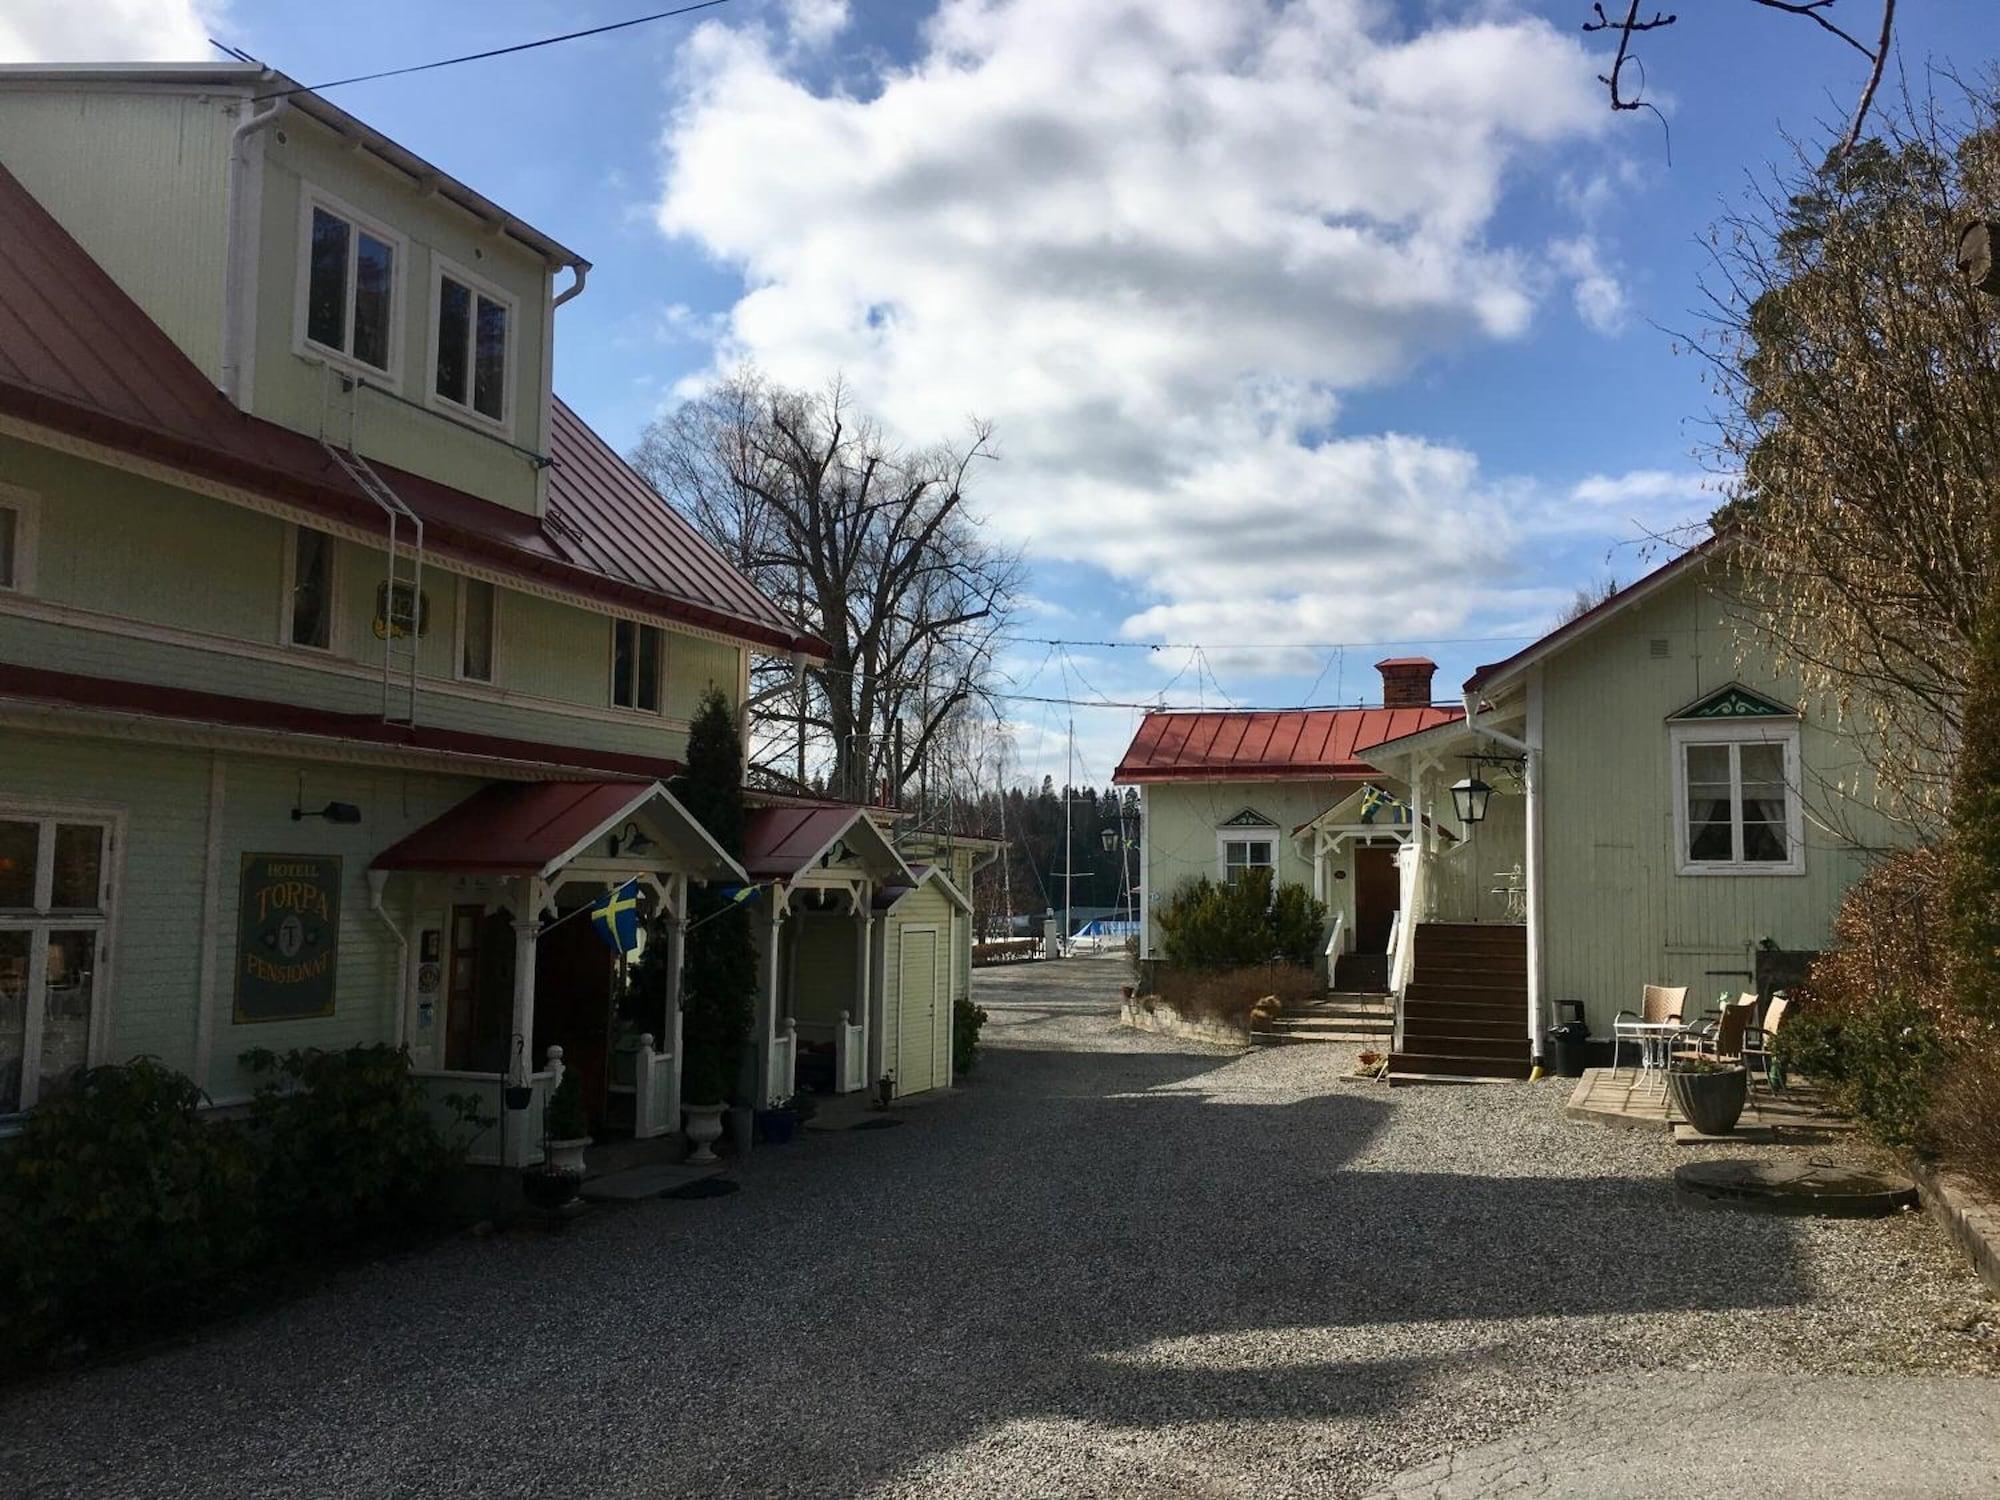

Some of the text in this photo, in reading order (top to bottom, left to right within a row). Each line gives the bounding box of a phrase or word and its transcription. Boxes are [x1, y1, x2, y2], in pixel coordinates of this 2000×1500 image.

[268, 863, 320, 878] HOTELL
[256, 880, 329, 925] TORPA
[246, 950, 331, 984] PENSIONAT
